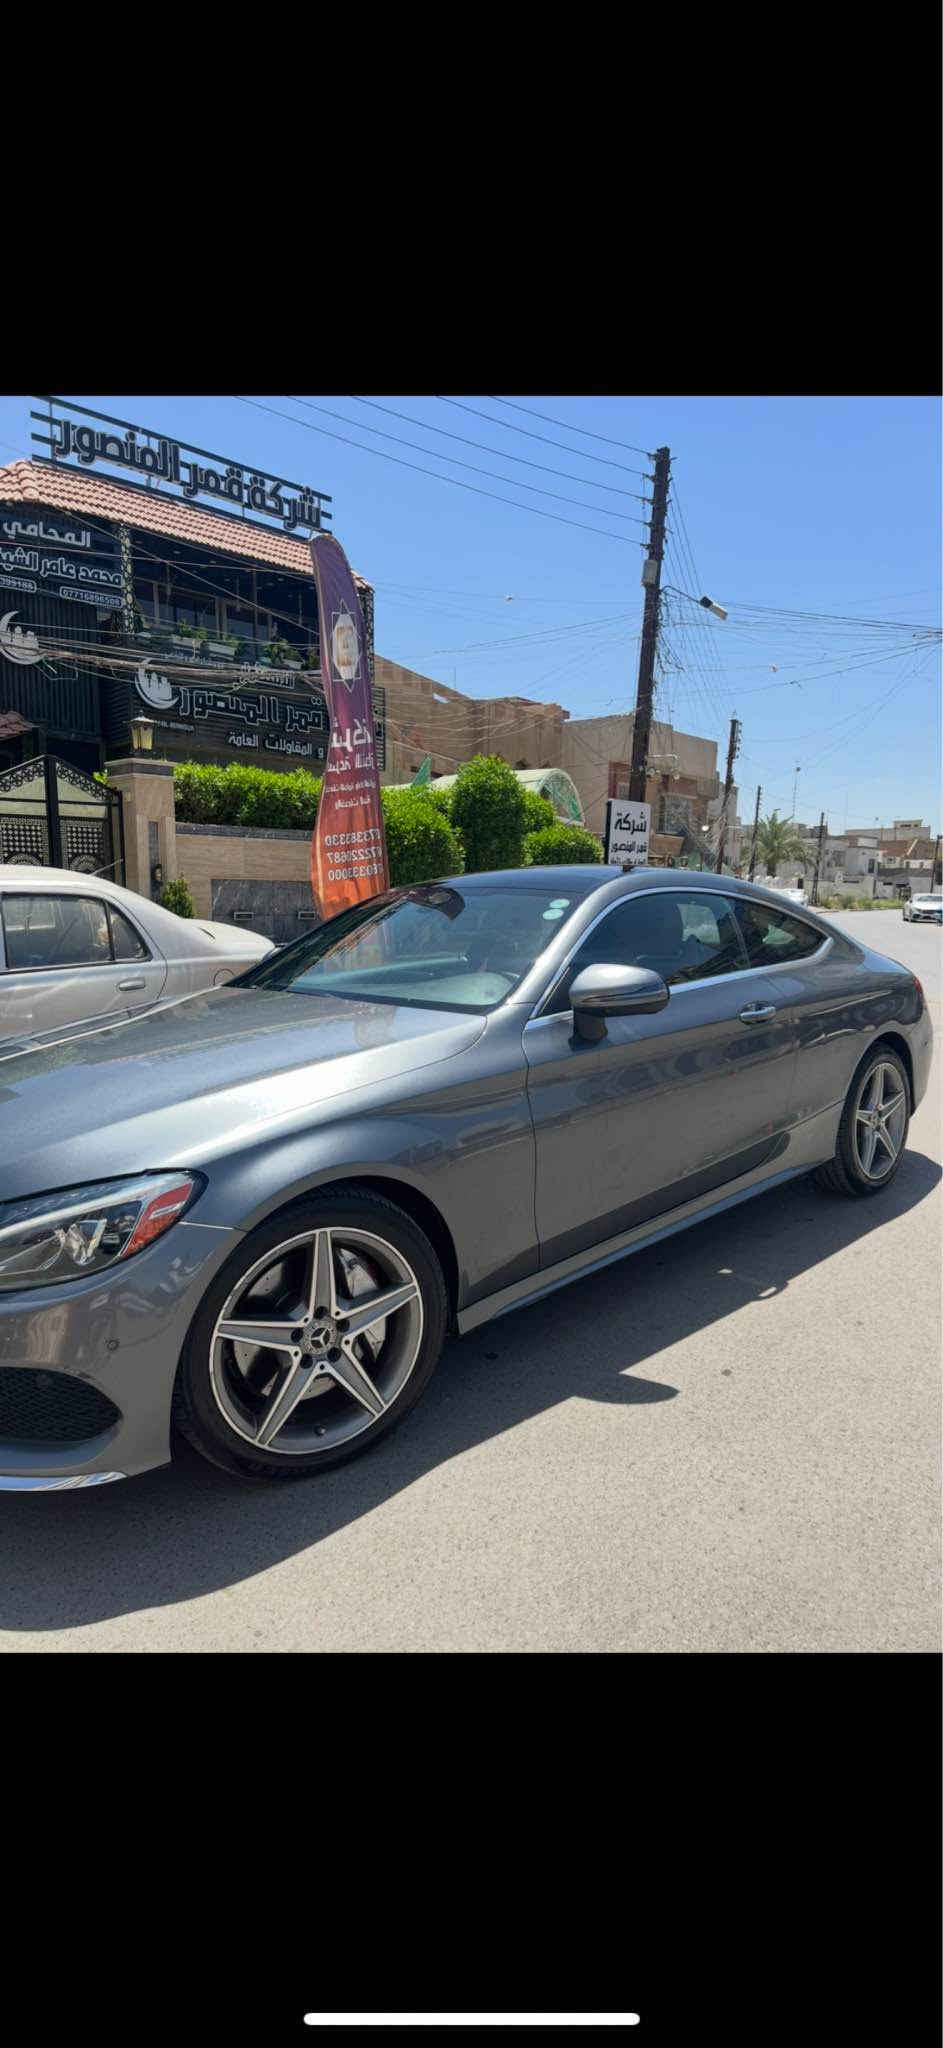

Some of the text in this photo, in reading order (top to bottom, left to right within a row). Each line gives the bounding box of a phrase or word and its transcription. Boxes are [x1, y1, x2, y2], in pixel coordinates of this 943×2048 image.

[54, 418, 323, 532] شركة قمر المنصور
[3, 520, 92, 548] المحامي
[40, 556, 77, 580] عامر
[78, 566, 124, 589] محمد
[227, 731, 260, 753] العامة
[265, 733, 313, 757] المقاولات
[614, 811, 647, 835] شركة
